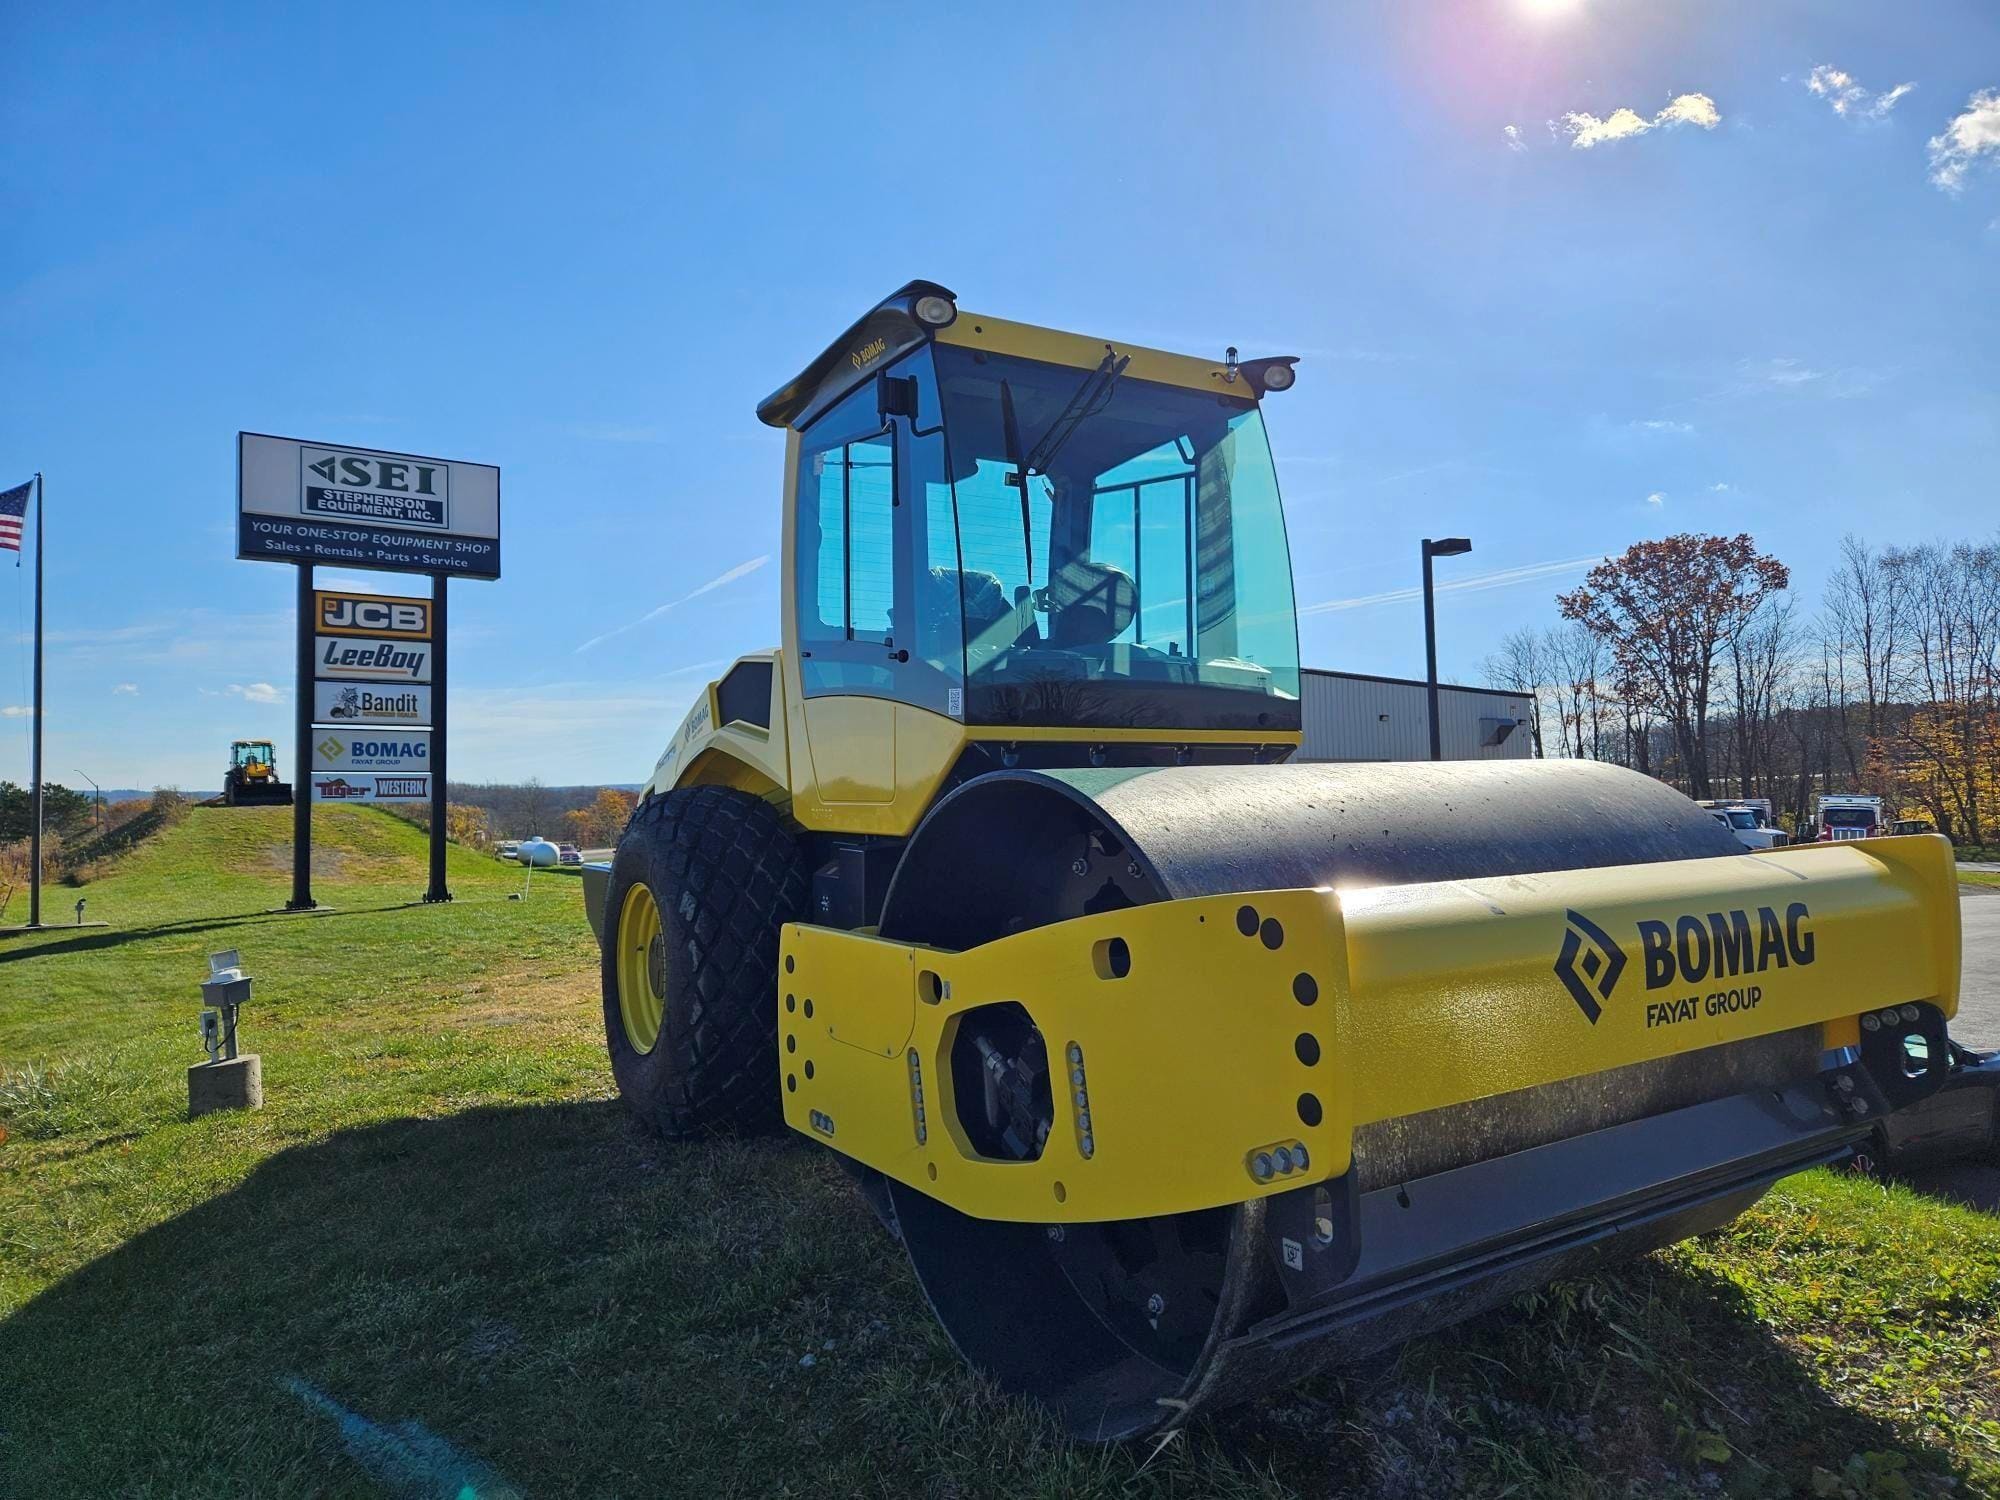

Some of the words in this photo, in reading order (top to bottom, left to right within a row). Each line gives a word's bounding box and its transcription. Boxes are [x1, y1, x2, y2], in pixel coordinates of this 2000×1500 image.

[860, 337, 886, 362] BOMAG
[340, 457, 437, 496] SEI
[317, 499, 404, 518] EQUIPMENT,
[407, 509, 436, 521] INC.
[323, 489, 426, 511] STEPHENSON
[251, 521, 293, 536] YOUR
[296, 526, 369, 543] ONE-STOP
[372, 534, 453, 551] EQUIPMENT
[455, 542, 491, 555] SHOP
[265, 539, 302, 553] Sales
[314, 543, 365, 559] Rentals
[376, 549, 411, 563] Parts
[422, 553, 469, 569] Service
[324, 599, 425, 632] JCB
[323, 640, 425, 678] LeeBoy
[361, 692, 419, 713] Bandit
[351, 741, 426, 758] BOMAG
[351, 758, 374, 766] FAYAT
[379, 780, 424, 795] WESTERN
[1636, 902, 1815, 991] BOMAG
[1646, 996, 1700, 1029] FAYAT
[1705, 986, 1762, 1017] GROUP
